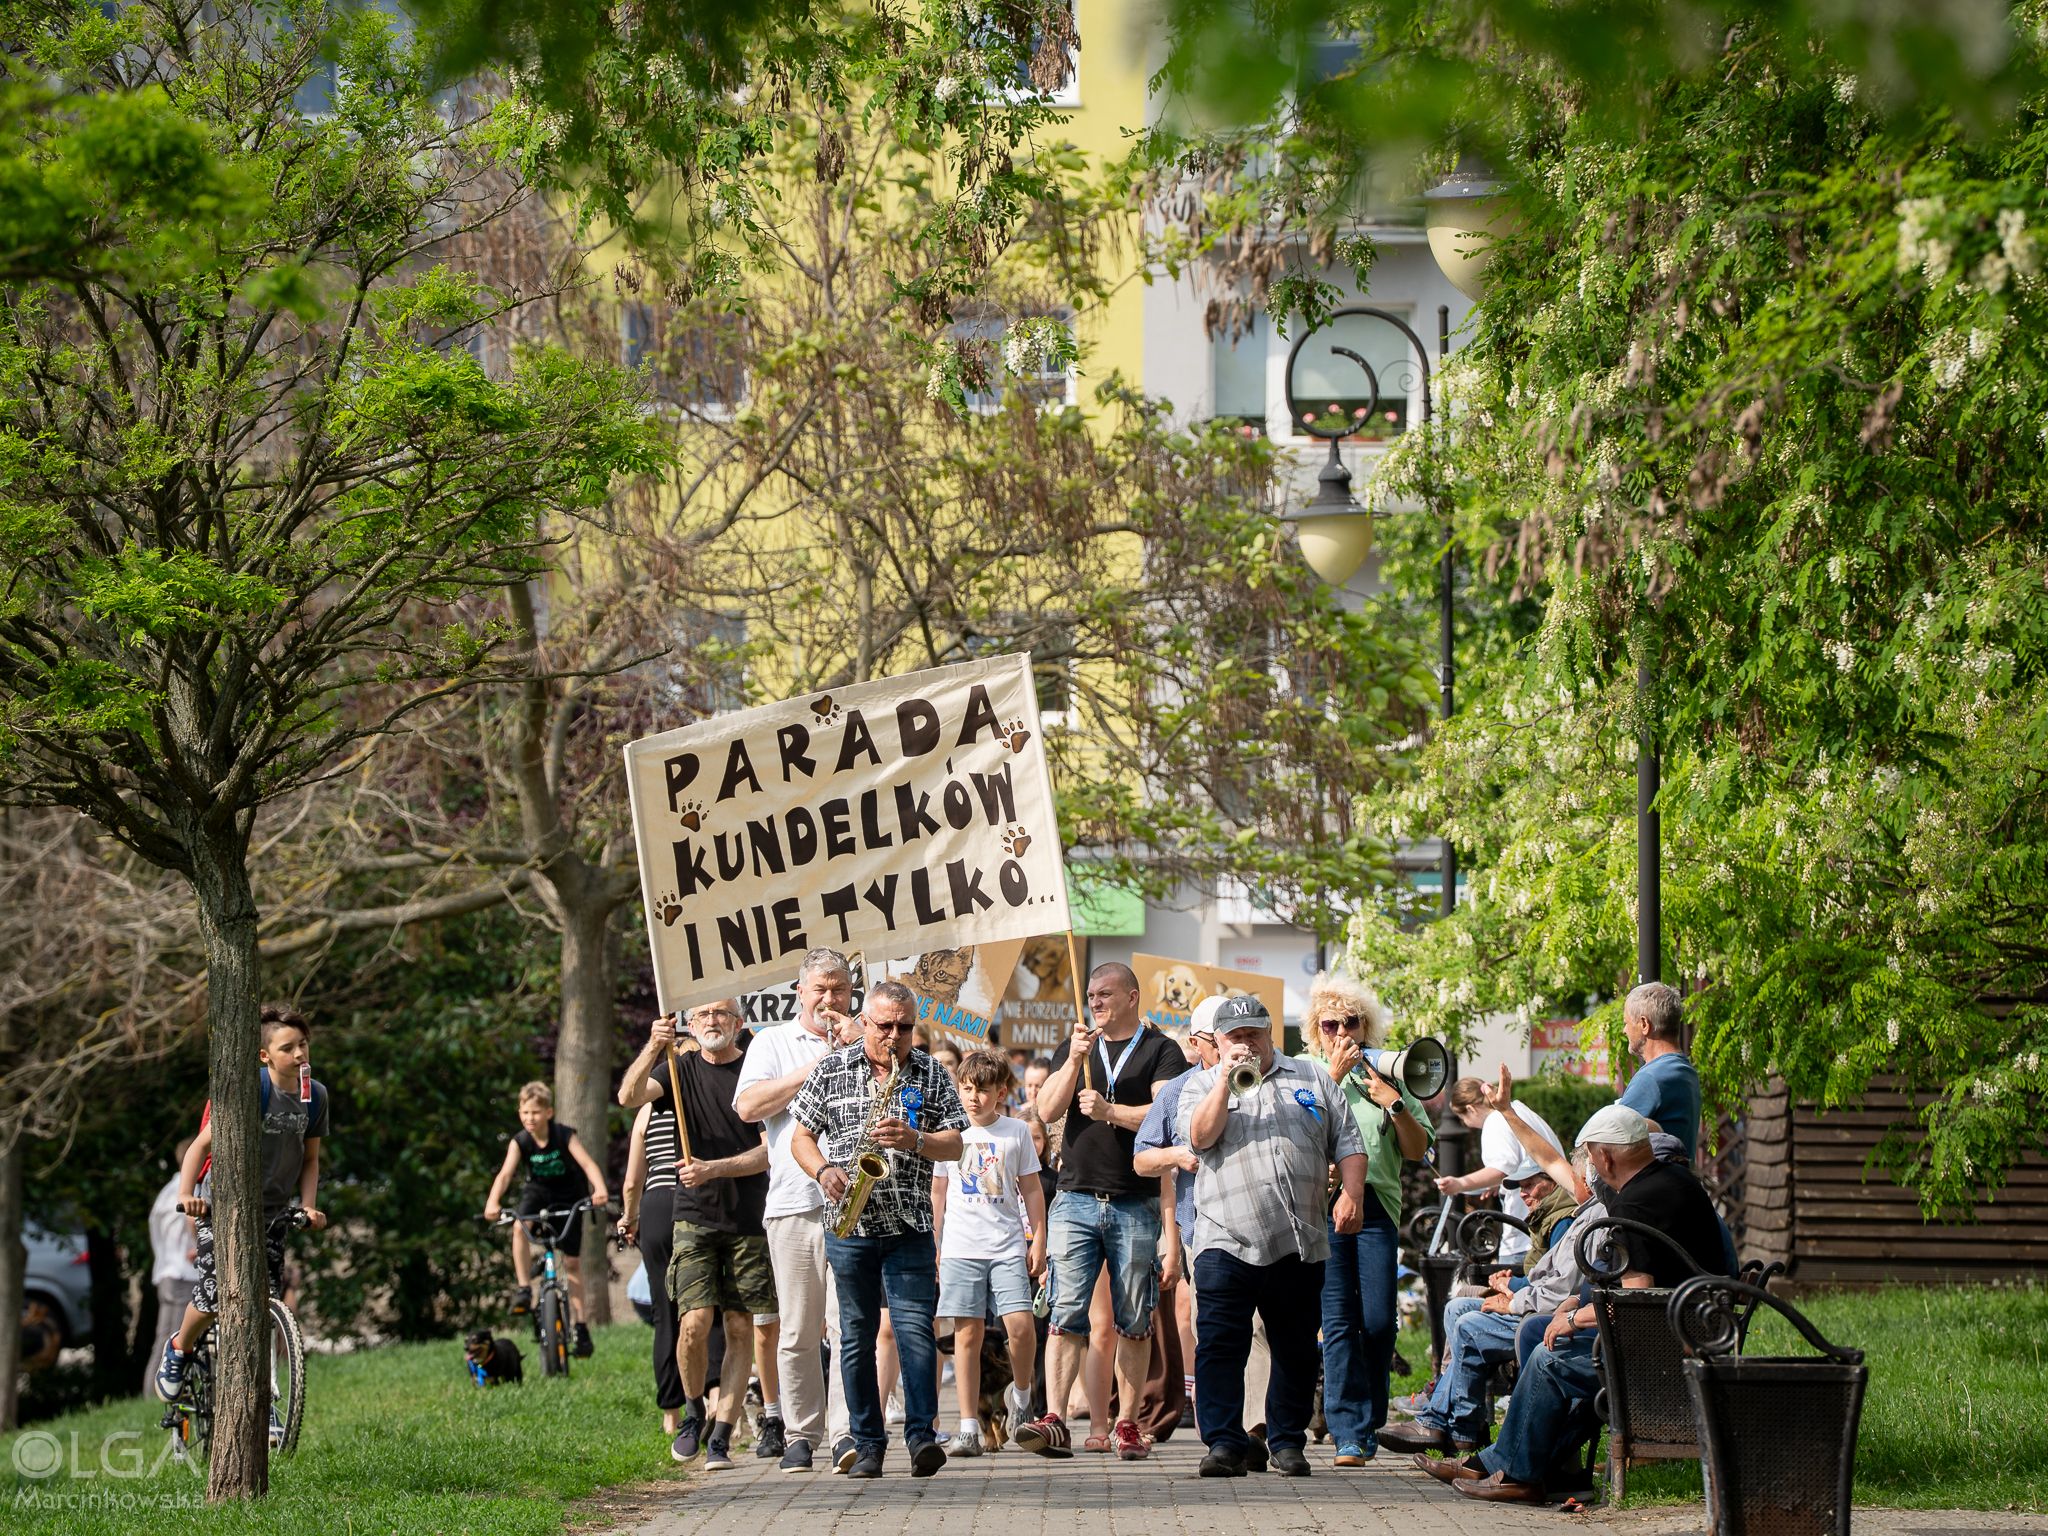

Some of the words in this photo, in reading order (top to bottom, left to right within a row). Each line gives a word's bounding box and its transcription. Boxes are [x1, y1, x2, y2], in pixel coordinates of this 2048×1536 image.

[663, 684, 1003, 813] PARADA
[672, 756, 1017, 898] KUNDELKÓW
[684, 923, 704, 981] I
[716, 897, 808, 971] NIE
[821, 859, 1055, 944] TYLKO...
[933, 1002, 989, 1039] NAMI
[1003, 1000, 1022, 1019] NIE
[1024, 1000, 1077, 1020] PORZUCA
[1233, 1002, 1249, 1016] M
[1012, 1022, 1058, 1044] MNIE
